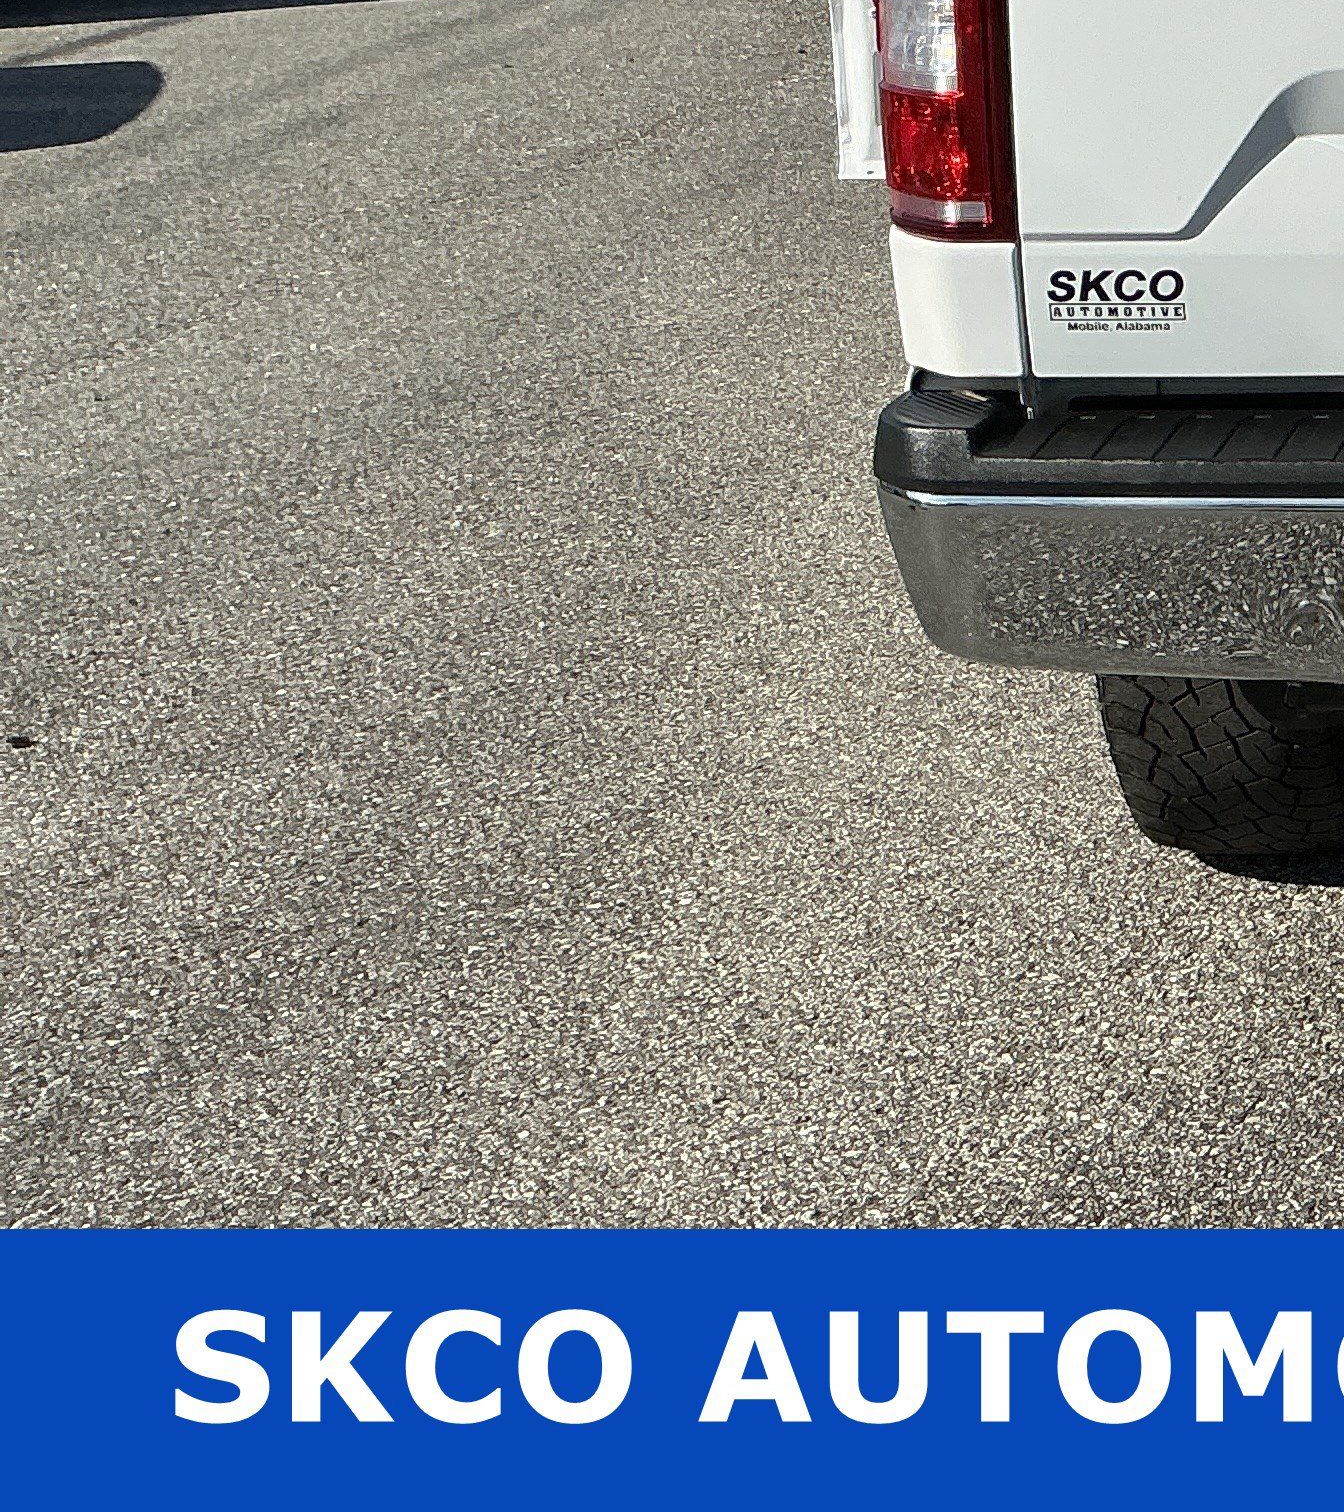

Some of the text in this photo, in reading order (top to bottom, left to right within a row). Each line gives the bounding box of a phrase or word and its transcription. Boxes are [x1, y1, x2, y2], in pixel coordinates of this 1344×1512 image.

[1046, 269, 1184, 303] SKCO
[1053, 306, 1183, 317] AUTOMOTIVE
[1067, 322, 1171, 332] Mobile, Alabama
